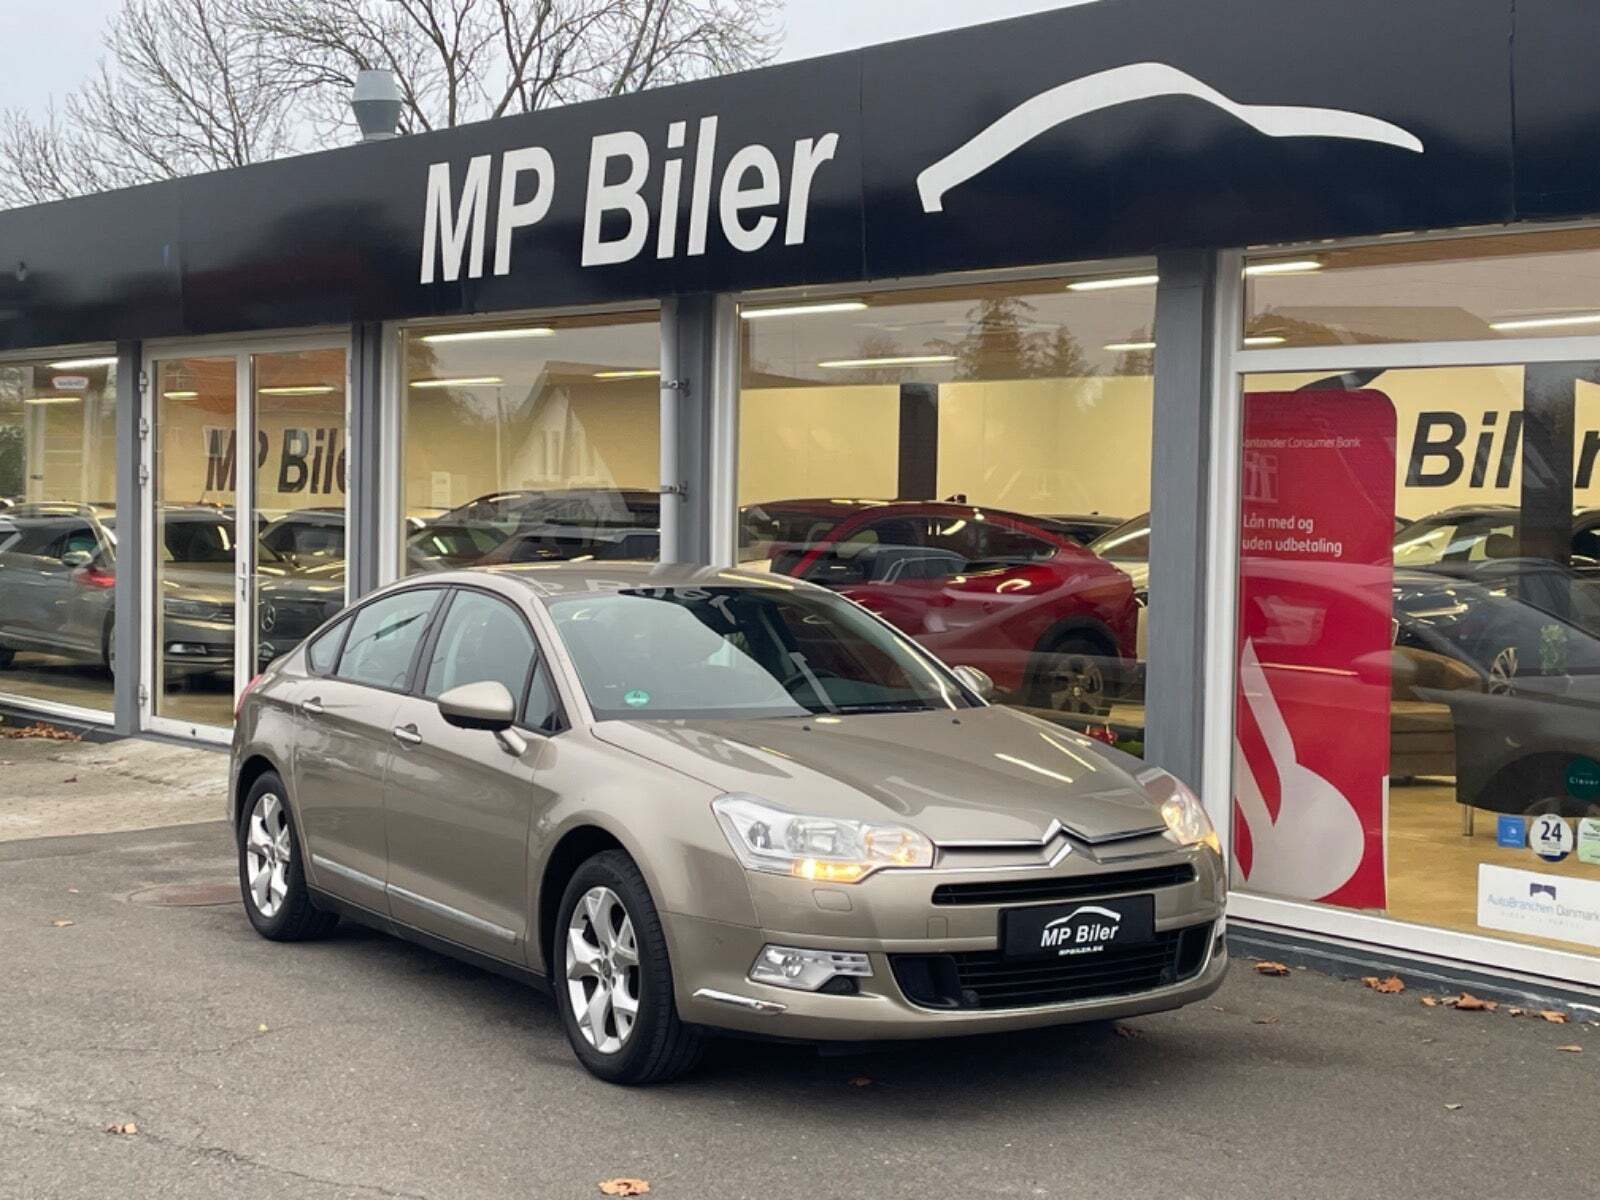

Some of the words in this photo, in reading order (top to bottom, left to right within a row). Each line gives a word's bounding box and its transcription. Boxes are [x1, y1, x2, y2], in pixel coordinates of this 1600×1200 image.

[420, 146, 555, 285] MP
[581, 115, 839, 268] Biler
[1243, 512, 1265, 528] Lån
[1267, 515, 1295, 529] med
[1297, 519, 1314, 534] og
[1242, 536, 1273, 551] uden
[1275, 538, 1342, 558] udbetaling
[1540, 820, 1563, 842] 24
[1041, 927, 1072, 947] MP
[1076, 923, 1119, 943] Biler
